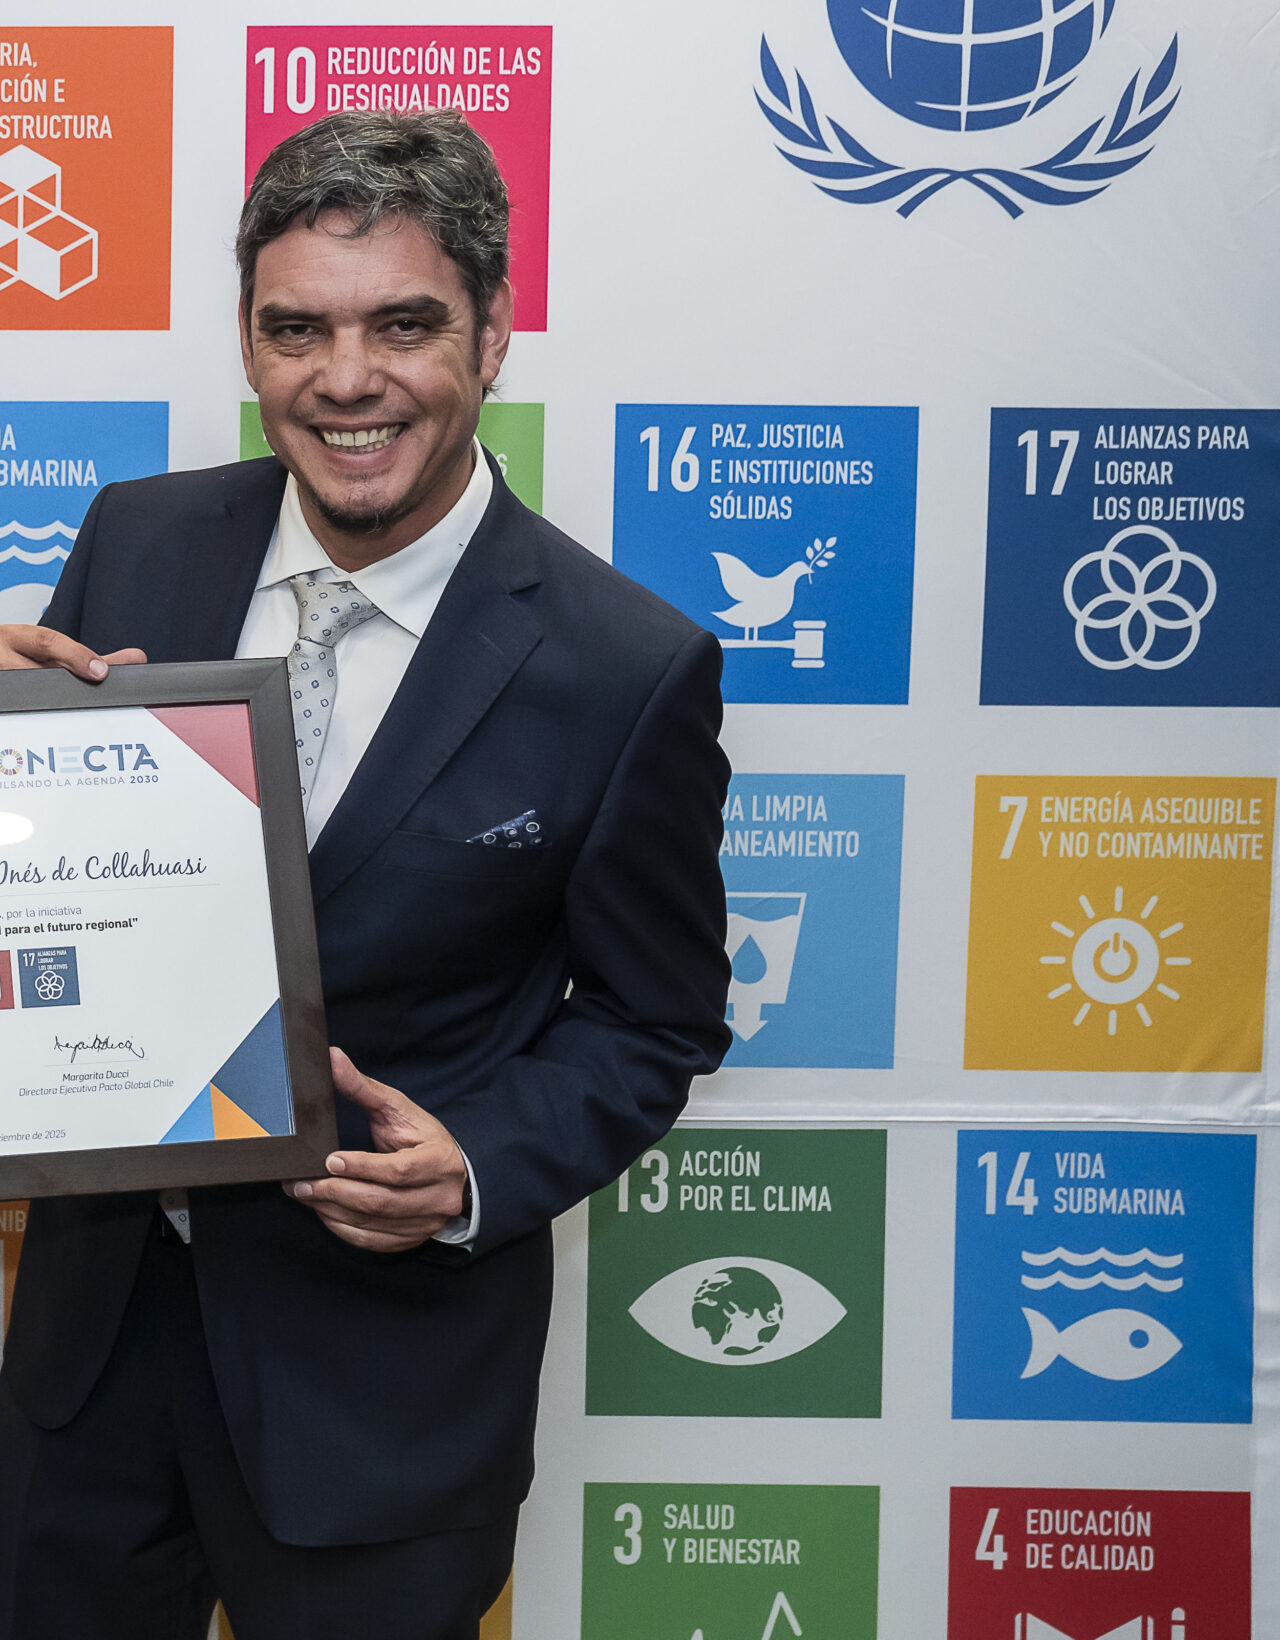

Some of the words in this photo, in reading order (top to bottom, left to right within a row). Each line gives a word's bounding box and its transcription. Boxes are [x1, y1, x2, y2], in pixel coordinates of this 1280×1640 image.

[328, 41, 454, 74] REDUCCIÓN
[464, 47, 491, 74] DE
[499, 47, 540, 75] LAS
[54, 79, 65, 102] E
[255, 47, 315, 113] 10
[327, 84, 509, 111] DESIGUALDADES
[712, 424, 751, 448] PAZ,
[758, 424, 843, 448] JUSTICIA
[1095, 425, 1190, 449] ALIANZAS
[1198, 426, 1249, 449] PARA
[640, 427, 699, 492] 16
[711, 460, 722, 483] E
[729, 460, 873, 484] INSTITUCIONES
[1018, 430, 1079, 495] 17
[1095, 461, 1173, 484] LOGRAR
[710, 490, 792, 519] SÓLIDAS
[1093, 497, 1130, 520] LOS
[1138, 497, 1244, 520] OBJETIVOS
[57, 779, 72, 787] LA
[77, 776, 125, 786] AGENDA
[130, 775, 159, 784] 2030
[752, 795, 827, 821] LIMPIA
[1041, 792, 1133, 823] ENERGÍA
[1140, 798, 1261, 824] ASEQUIBLE
[1000, 796, 1028, 859] 7
[719, 830, 859, 857] ANEAMIENTO
[1039, 832, 1052, 857] Y
[1060, 832, 1088, 857] NO
[1097, 832, 1263, 859] CONTAMINANTE
[52, 856, 79, 881] de
[85, 849, 207, 880] Collahuasi
[6, 910, 22, 921] por
[26, 908, 35, 918] la
[38, 905, 82, 917] iniciativa
[4, 925, 31, 937] para
[34, 923, 45, 933] el
[47, 921, 82, 932] futuro
[22, 953, 35, 967] 17
[19, 1087, 57, 1097] Directora
[60, 1084, 97, 1096] Ejecutiva
[99, 1082, 123, 1091] Pacto
[124, 1080, 151, 1090] Global
[153, 1078, 175, 1088] Chile
[62, 1072, 104, 1083] Margarita
[106, 1070, 129, 1079] Ducci
[32, 1131, 43, 1140] de
[44, 1129, 66, 1139] 2025
[680, 1145, 760, 1176] ACCIÓN
[1055, 1153, 1105, 1178] VIDA
[618, 1149, 669, 1213] 13
[978, 1152, 1038, 1215] 14
[680, 1185, 723, 1210] POR
[731, 1186, 756, 1211] EL
[764, 1186, 831, 1211] CLIMA
[1054, 1187, 1184, 1215] SUBMARINA
[664, 1504, 734, 1529] SALUD
[1027, 1505, 1150, 1536] EDUCACIÓN
[614, 1503, 642, 1565] 3
[976, 1508, 1007, 1570] 4
[663, 1538, 677, 1563] Y
[684, 1538, 800, 1564] BIENESTAR
[1026, 1543, 1053, 1568] DE
[1061, 1544, 1153, 1571] CALIDAD
